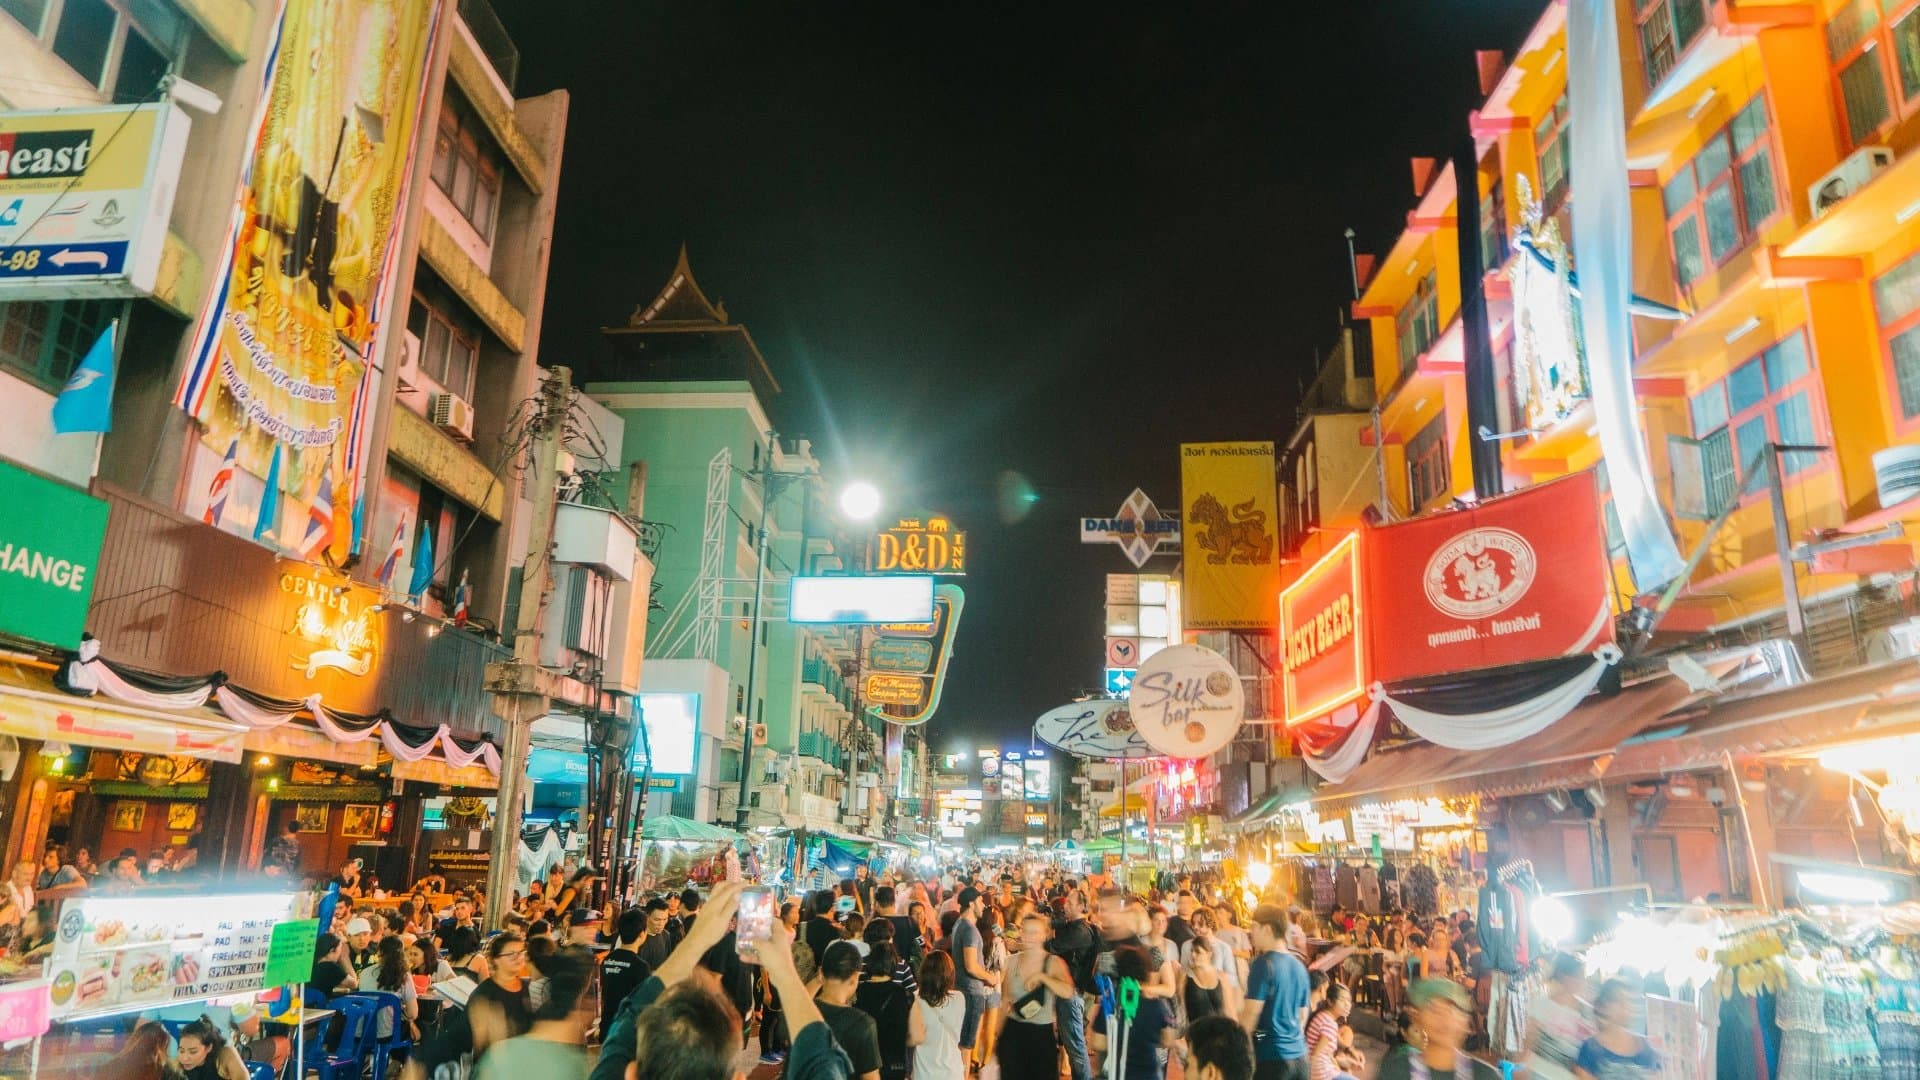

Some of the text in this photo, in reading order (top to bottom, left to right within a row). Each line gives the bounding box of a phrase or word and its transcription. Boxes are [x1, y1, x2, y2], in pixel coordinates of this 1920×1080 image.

[877, 532, 950, 571] D&D
[951, 534, 963, 570] INN
[280, 574, 349, 616] CENTER
[1283, 592, 1352, 673] LUCKY BEER
[1139, 671, 1207, 709] Silk
[1054, 710, 1101, 744] The
[1162, 701, 1192, 728] bar
[214, 937, 231, 946] PAD
[239, 936, 254, 945] THAI
